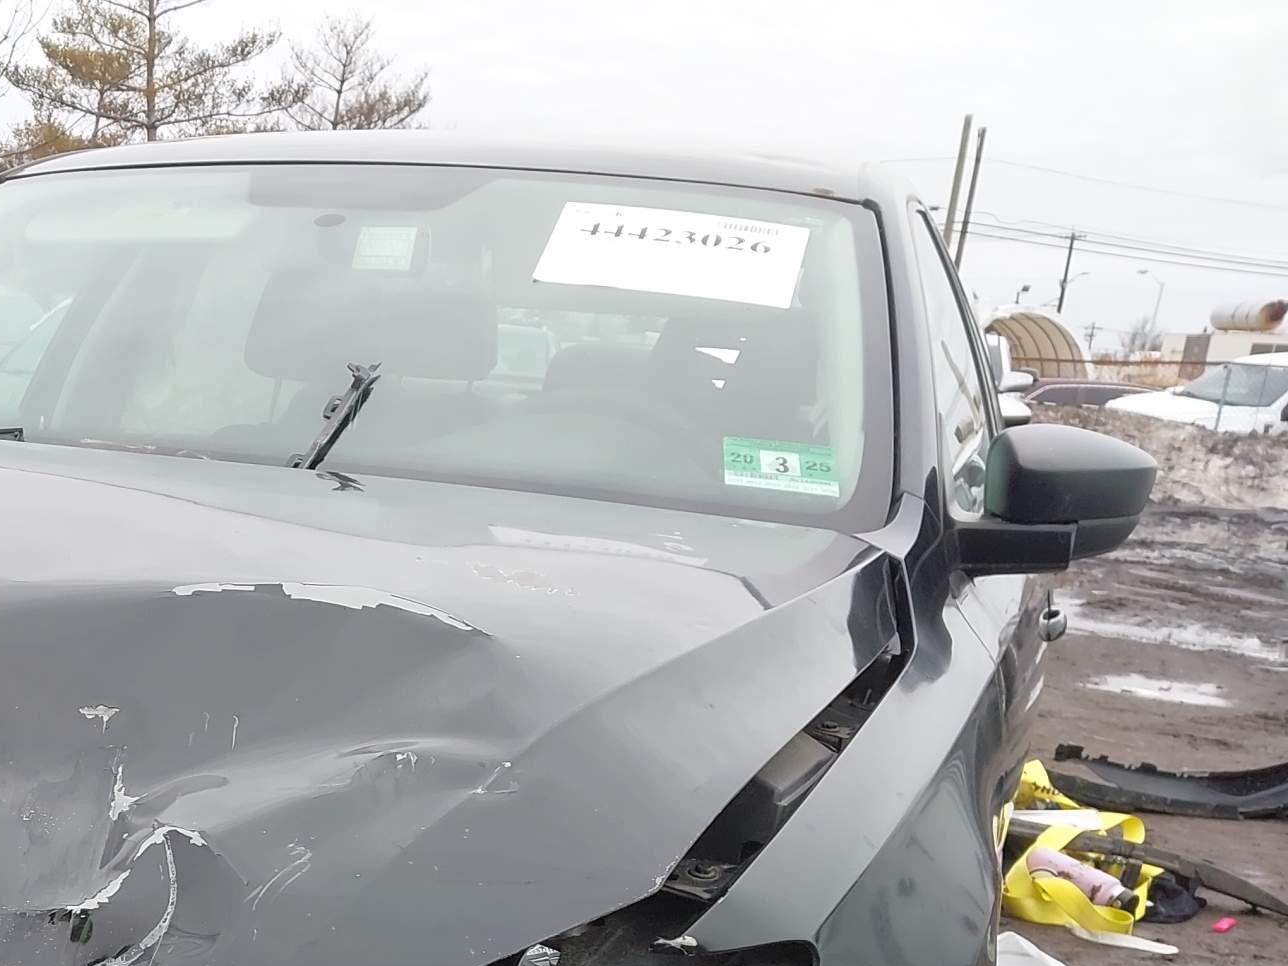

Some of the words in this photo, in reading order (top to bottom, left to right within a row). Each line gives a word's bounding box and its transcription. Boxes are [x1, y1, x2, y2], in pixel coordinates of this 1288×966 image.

[579, 222, 771, 254] 44423026
[730, 452, 755, 465] 20
[774, 456, 790, 474] 3
[805, 460, 832, 473] 25
